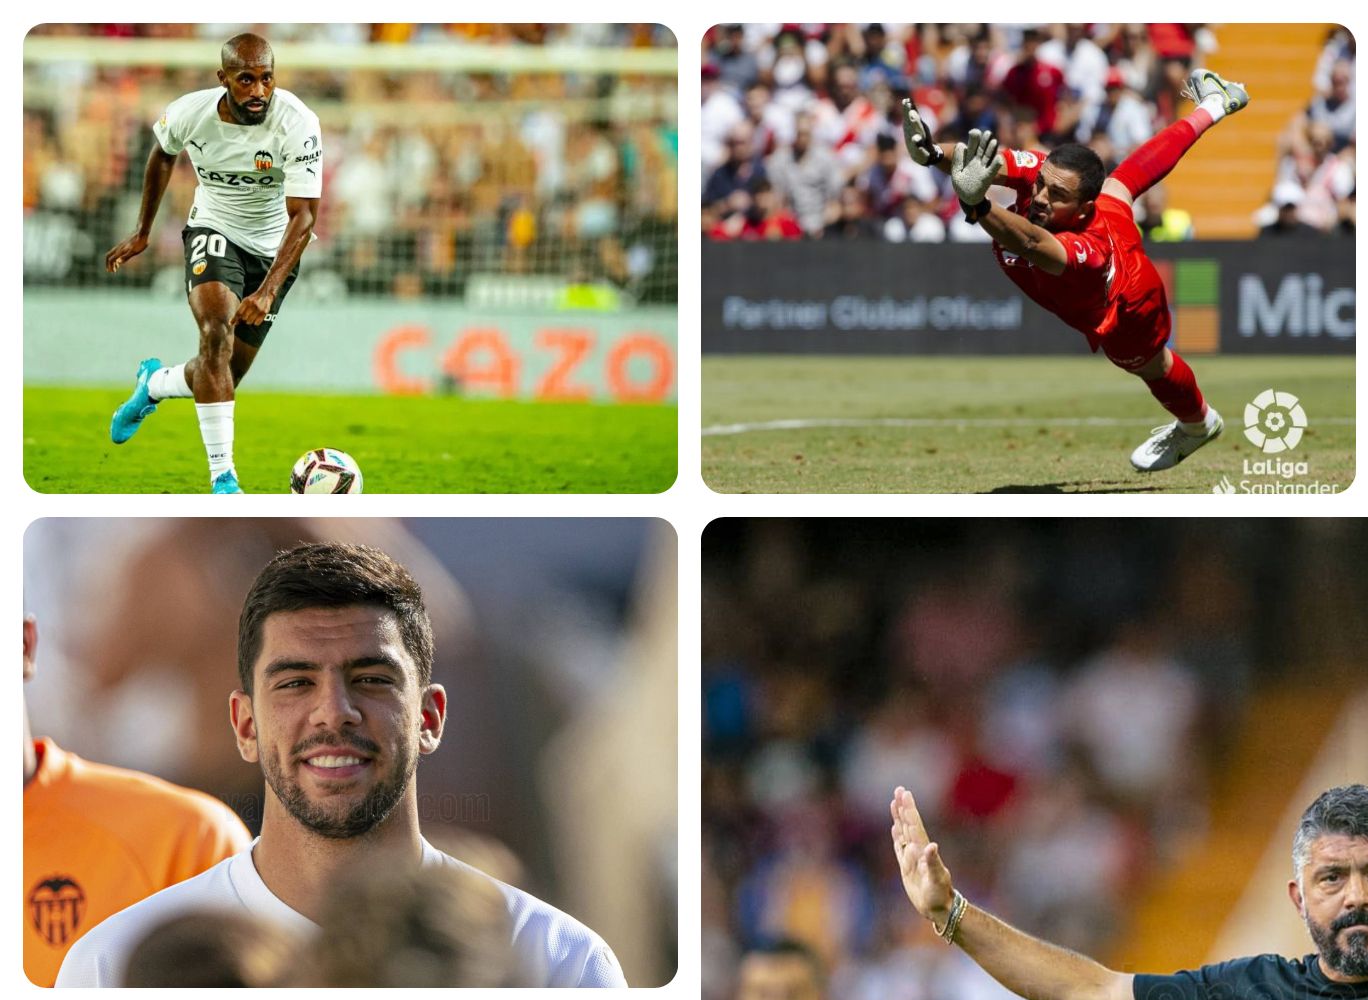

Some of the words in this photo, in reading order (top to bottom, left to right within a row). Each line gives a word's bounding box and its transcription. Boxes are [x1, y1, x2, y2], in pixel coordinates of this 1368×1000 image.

[197, 166, 274, 186] CAZOO
[190, 233, 227, 264] 20
[372, 325, 676, 406] CAZO
